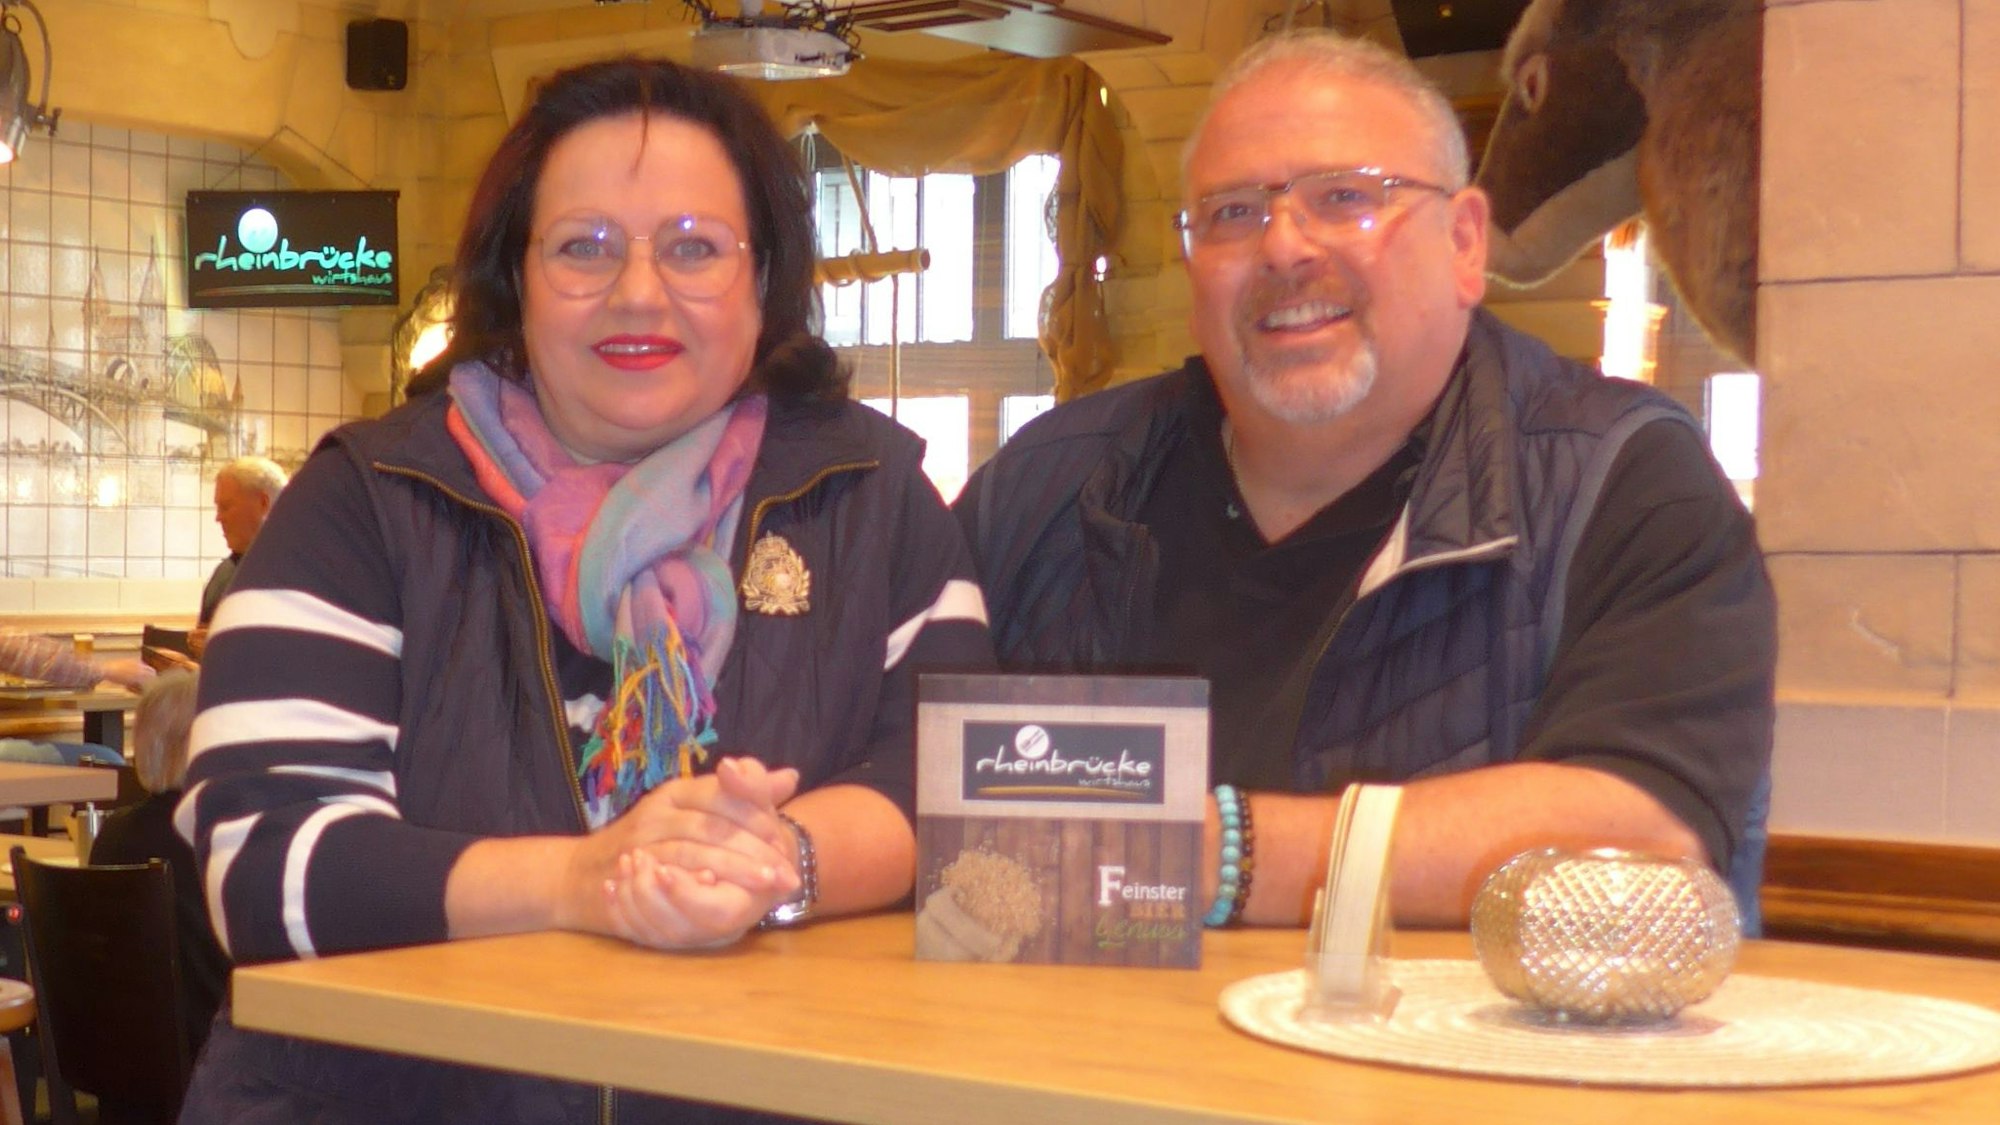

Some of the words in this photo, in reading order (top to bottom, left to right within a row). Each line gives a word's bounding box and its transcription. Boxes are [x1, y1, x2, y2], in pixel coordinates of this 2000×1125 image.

[194, 235, 393, 271] rheinbrücke
[975, 745, 1151, 775] rheinbrücke
[1098, 865, 1186, 906] Feinster
